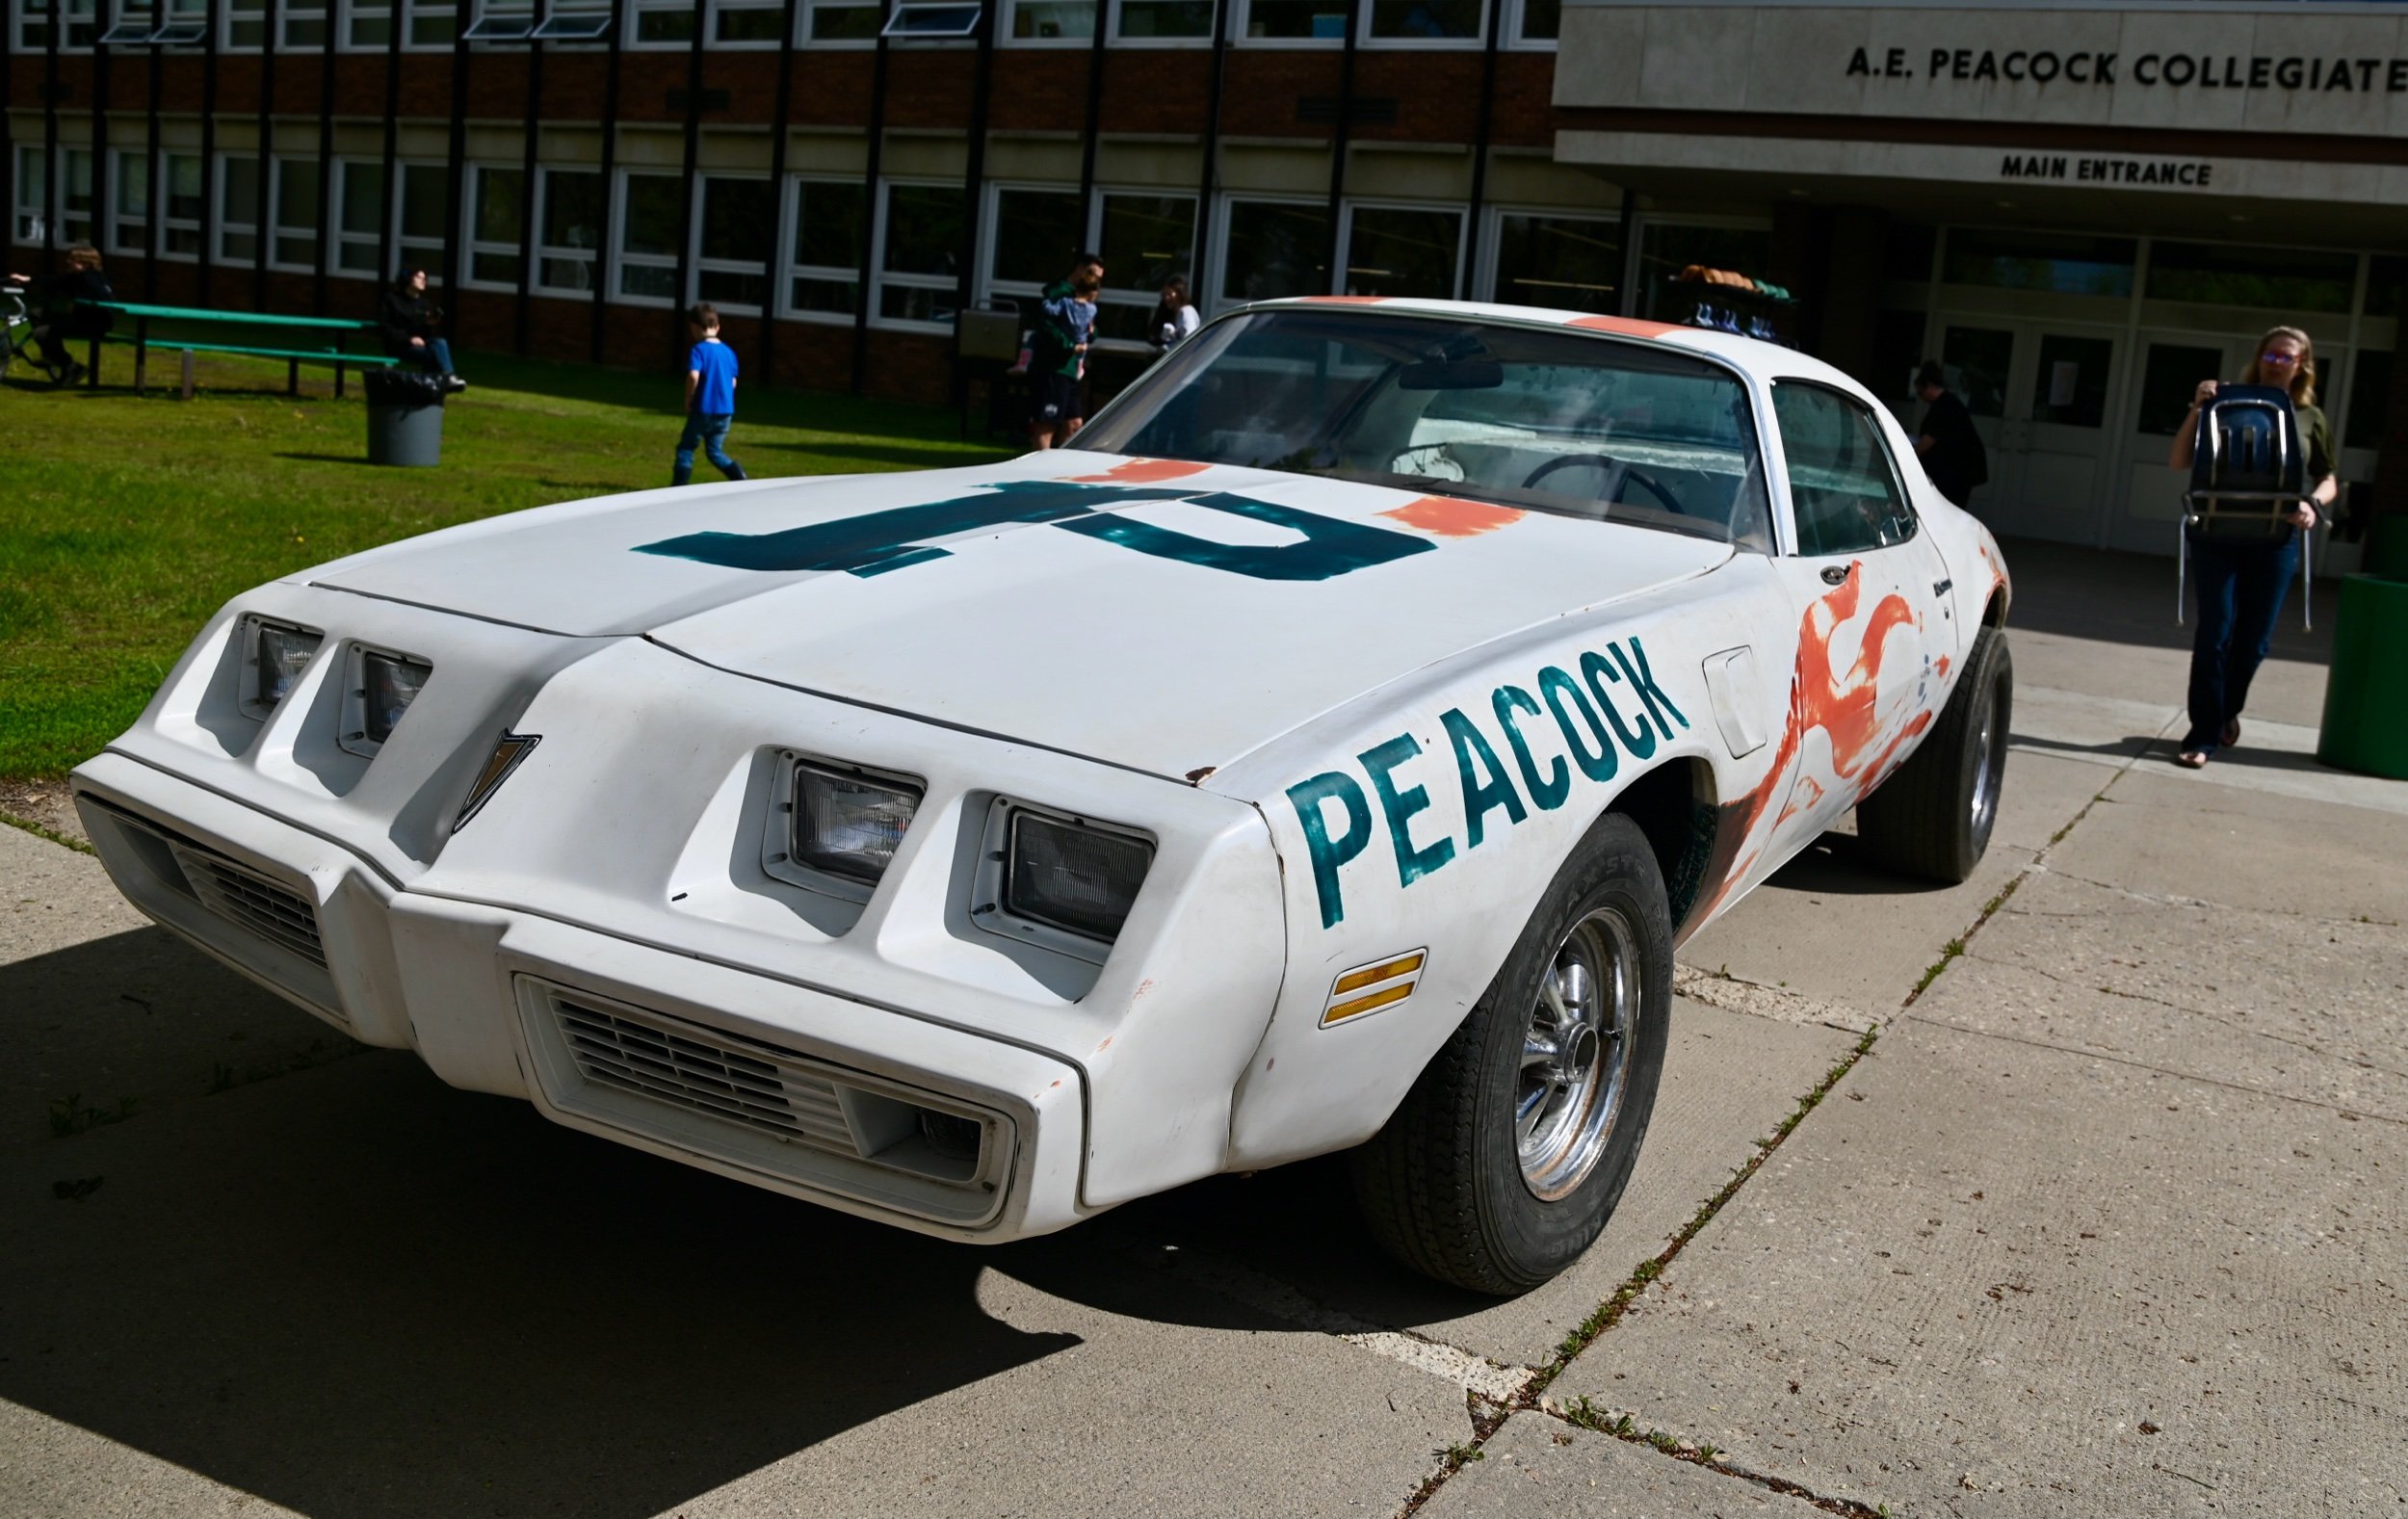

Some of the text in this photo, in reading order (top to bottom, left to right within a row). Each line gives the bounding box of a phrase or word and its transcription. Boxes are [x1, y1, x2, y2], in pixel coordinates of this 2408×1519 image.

[1845, 46, 2408, 93] A.E. PEACOCK COLLEGIATE
[2002, 156, 2212, 186] MAIN ENTRANCE
[1286, 636, 1690, 930] PEACOCK
